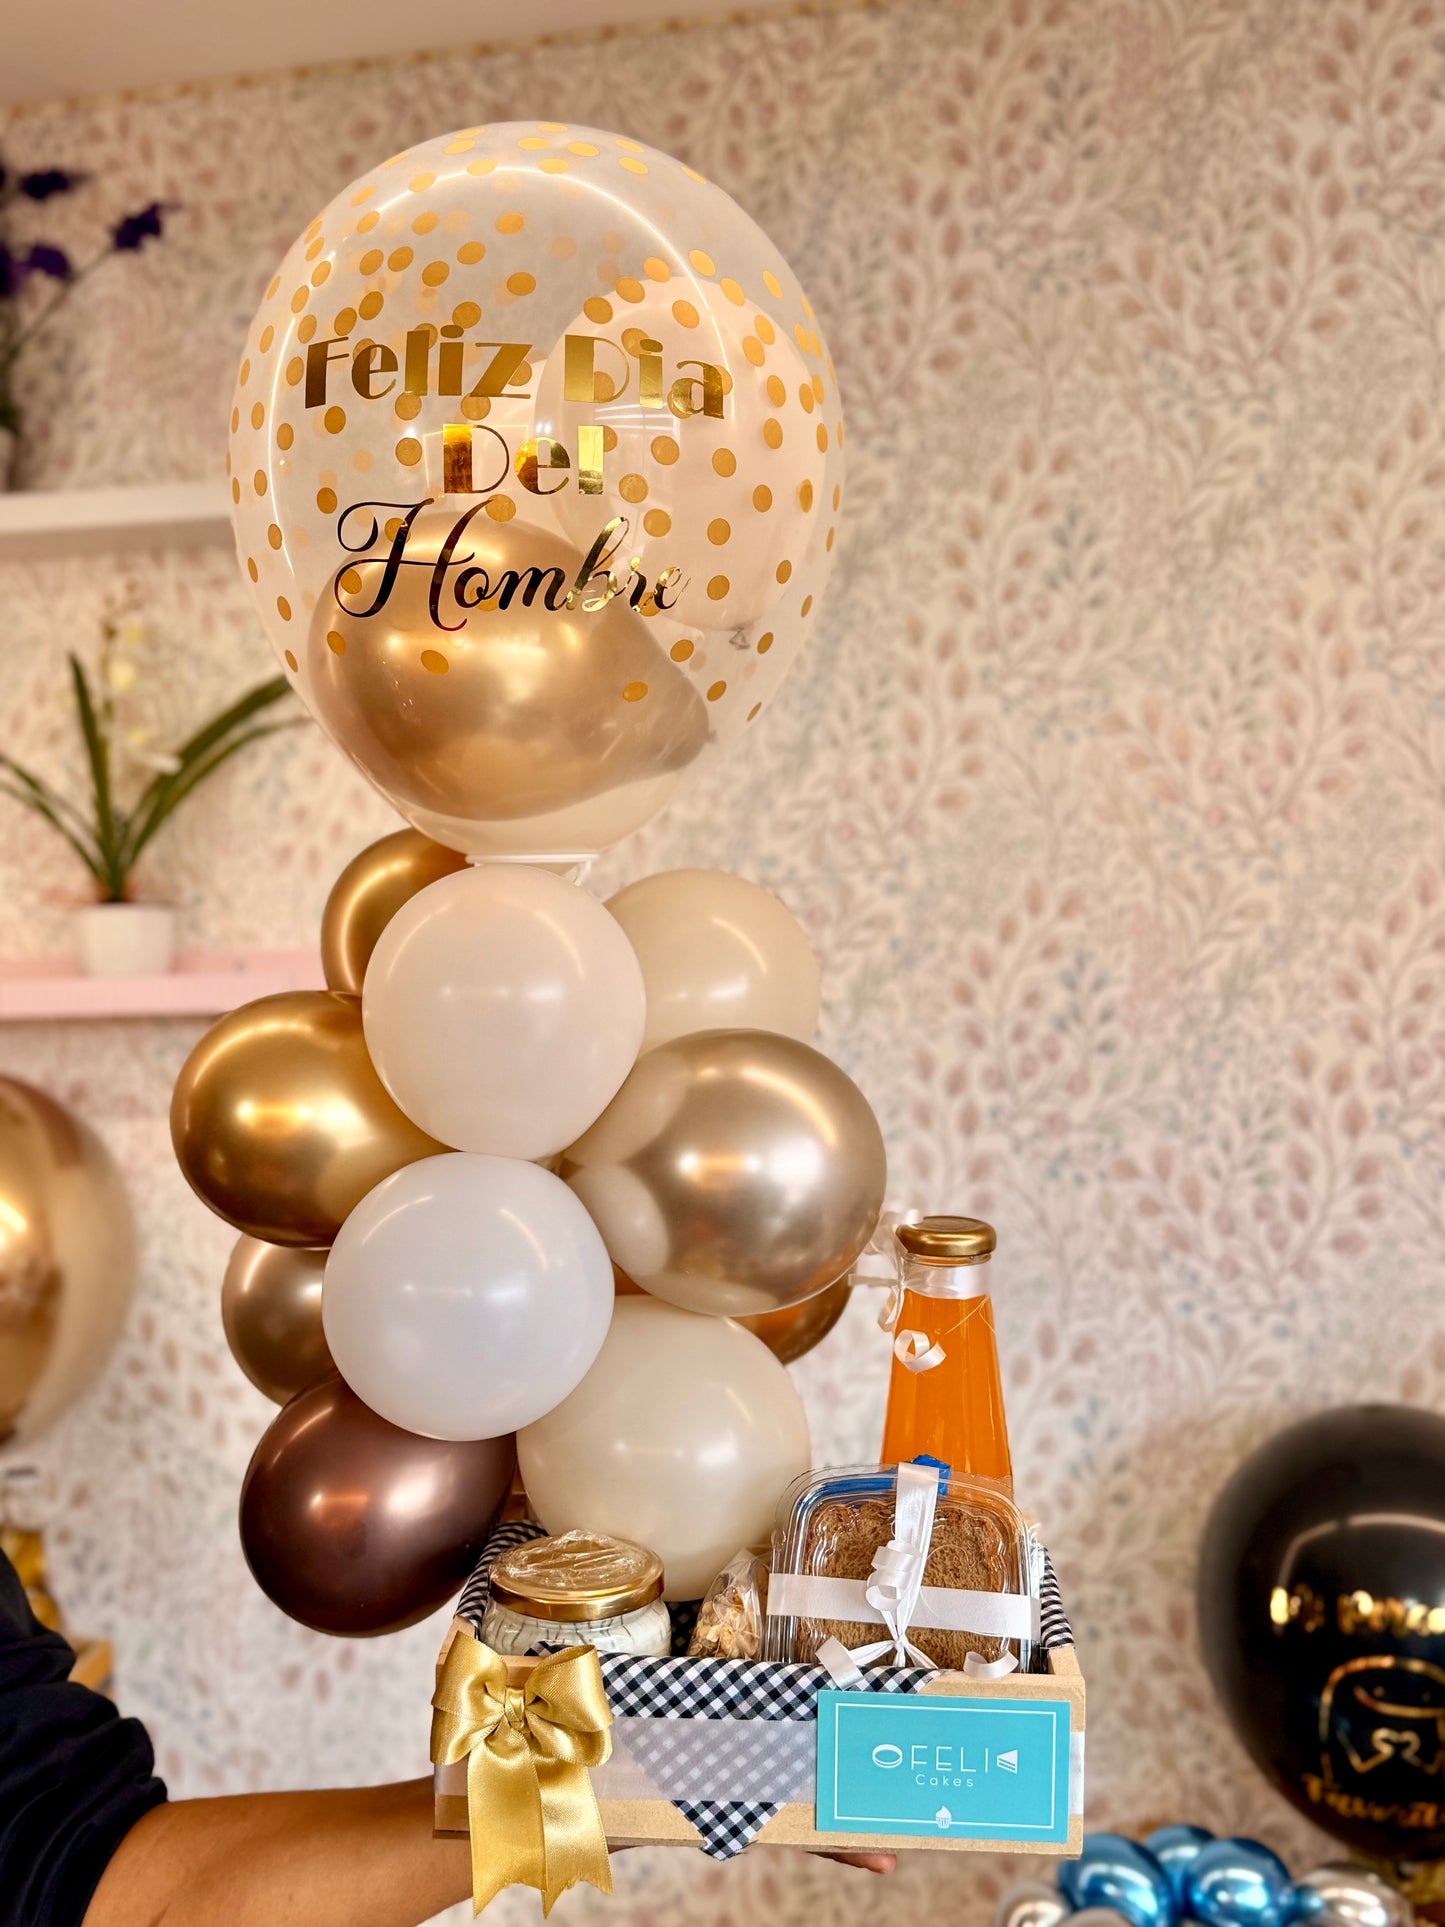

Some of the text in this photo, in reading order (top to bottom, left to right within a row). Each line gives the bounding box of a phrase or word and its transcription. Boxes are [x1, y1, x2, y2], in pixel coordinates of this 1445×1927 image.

[303, 324, 724, 419] Feliz Dia
[442, 423, 604, 495] Del
[333, 497, 691, 632] Hombre
[915, 1774, 974, 1787] Cakes
